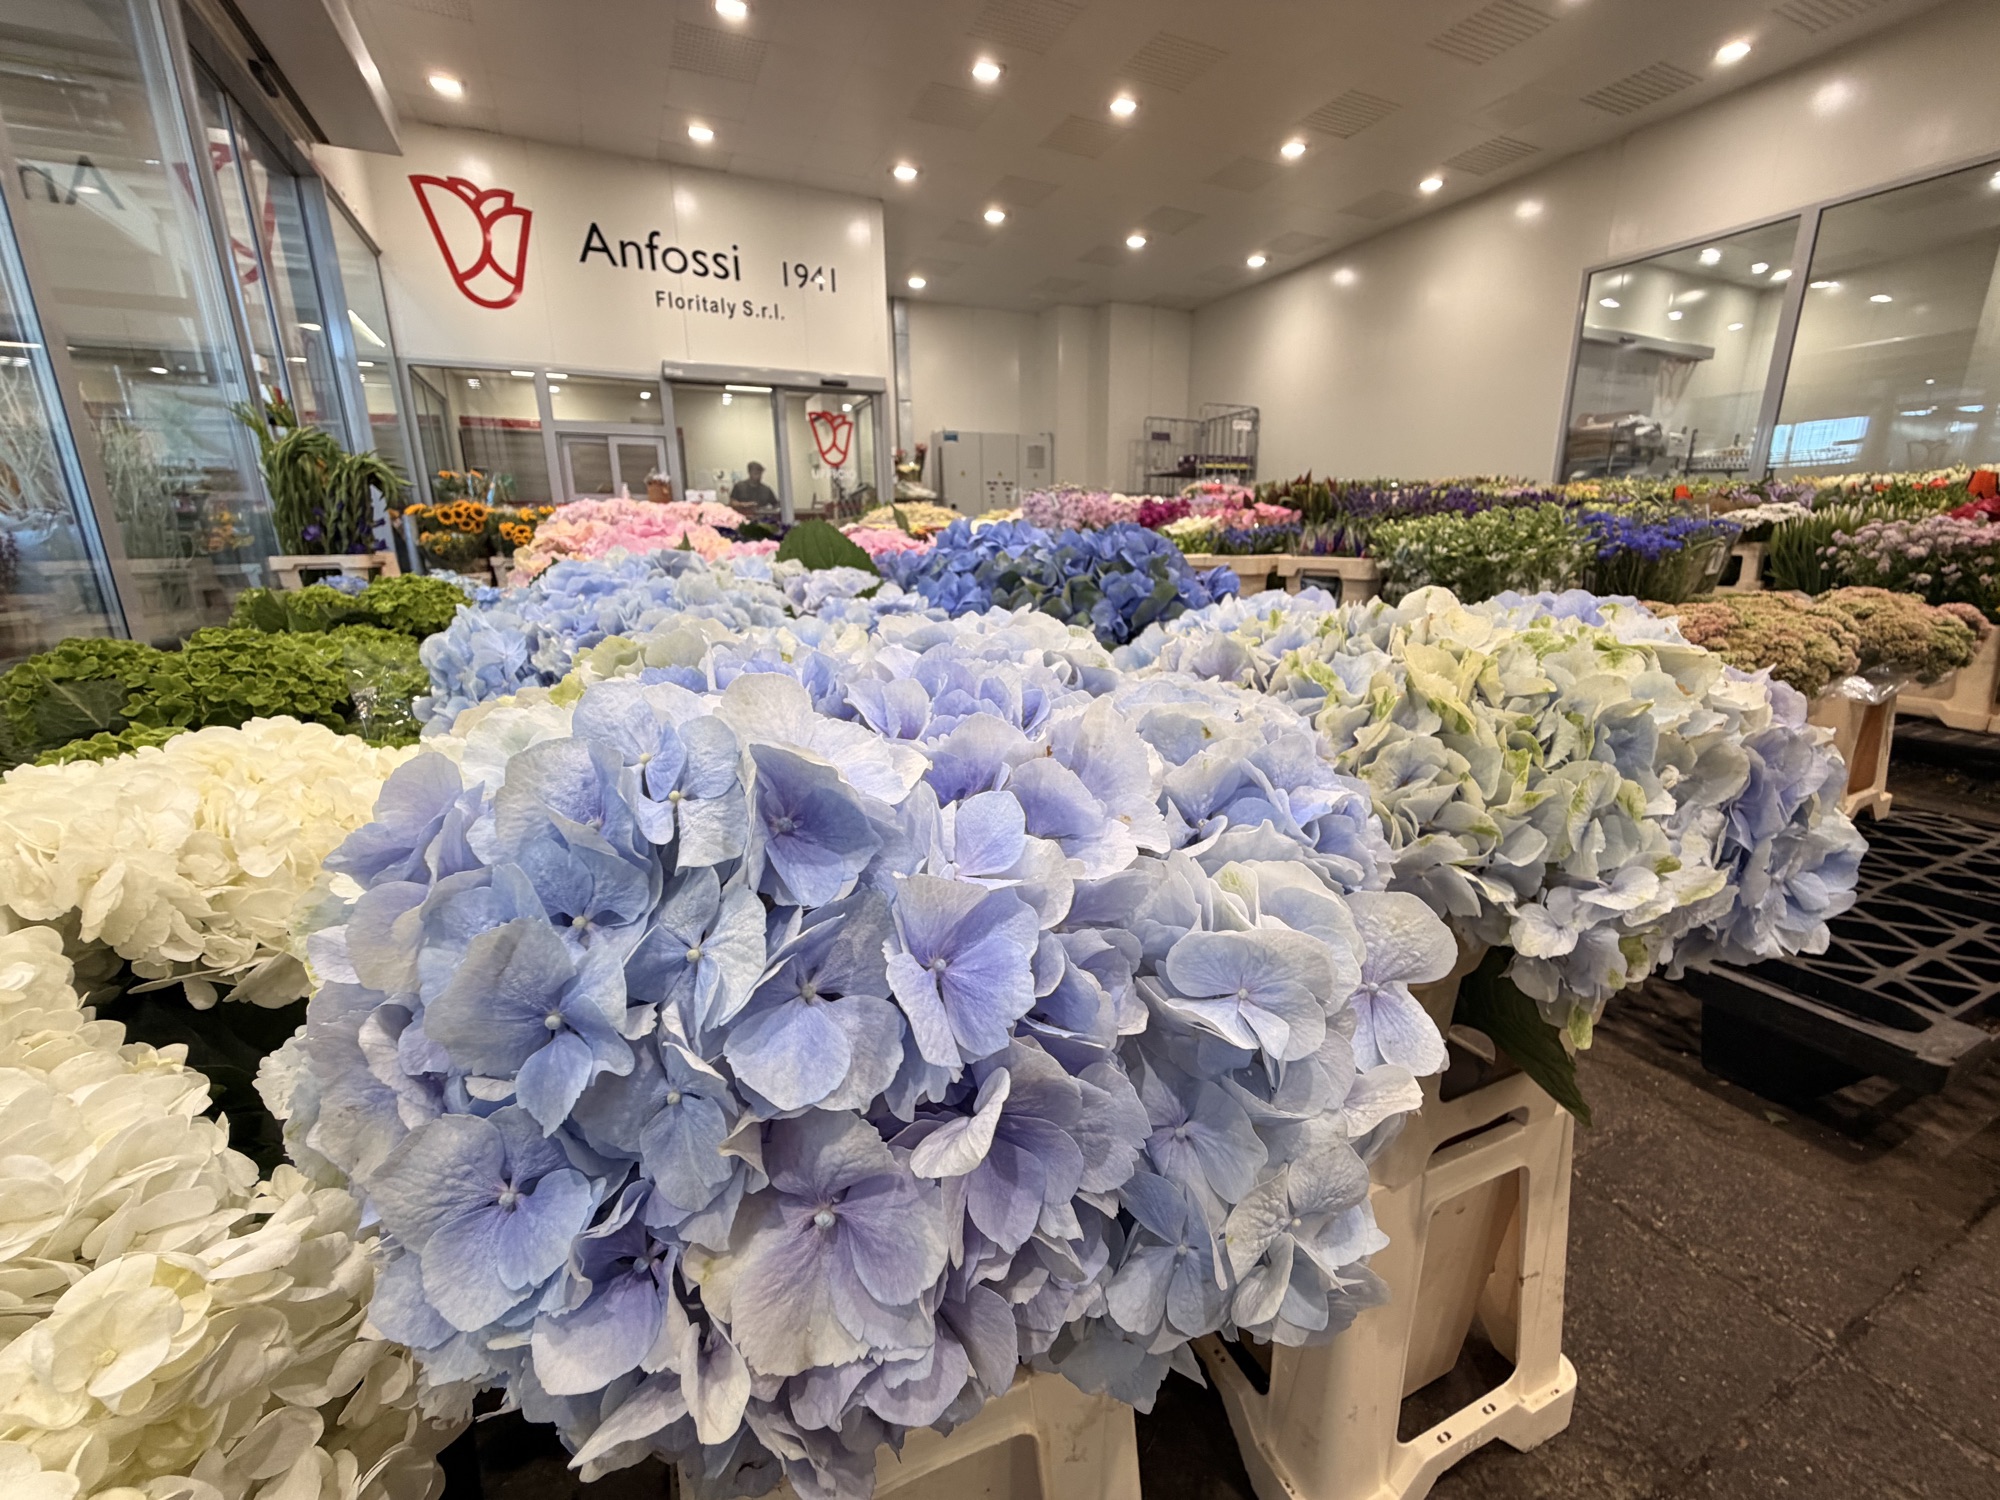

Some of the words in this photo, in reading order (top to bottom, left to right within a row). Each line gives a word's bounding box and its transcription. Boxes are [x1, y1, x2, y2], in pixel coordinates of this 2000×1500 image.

[579, 222, 741, 281] Anfossi
[783, 261, 836, 293] 1941
[655, 290, 736, 319] Floritaly
[743, 300, 785, 320] S.r.l.
